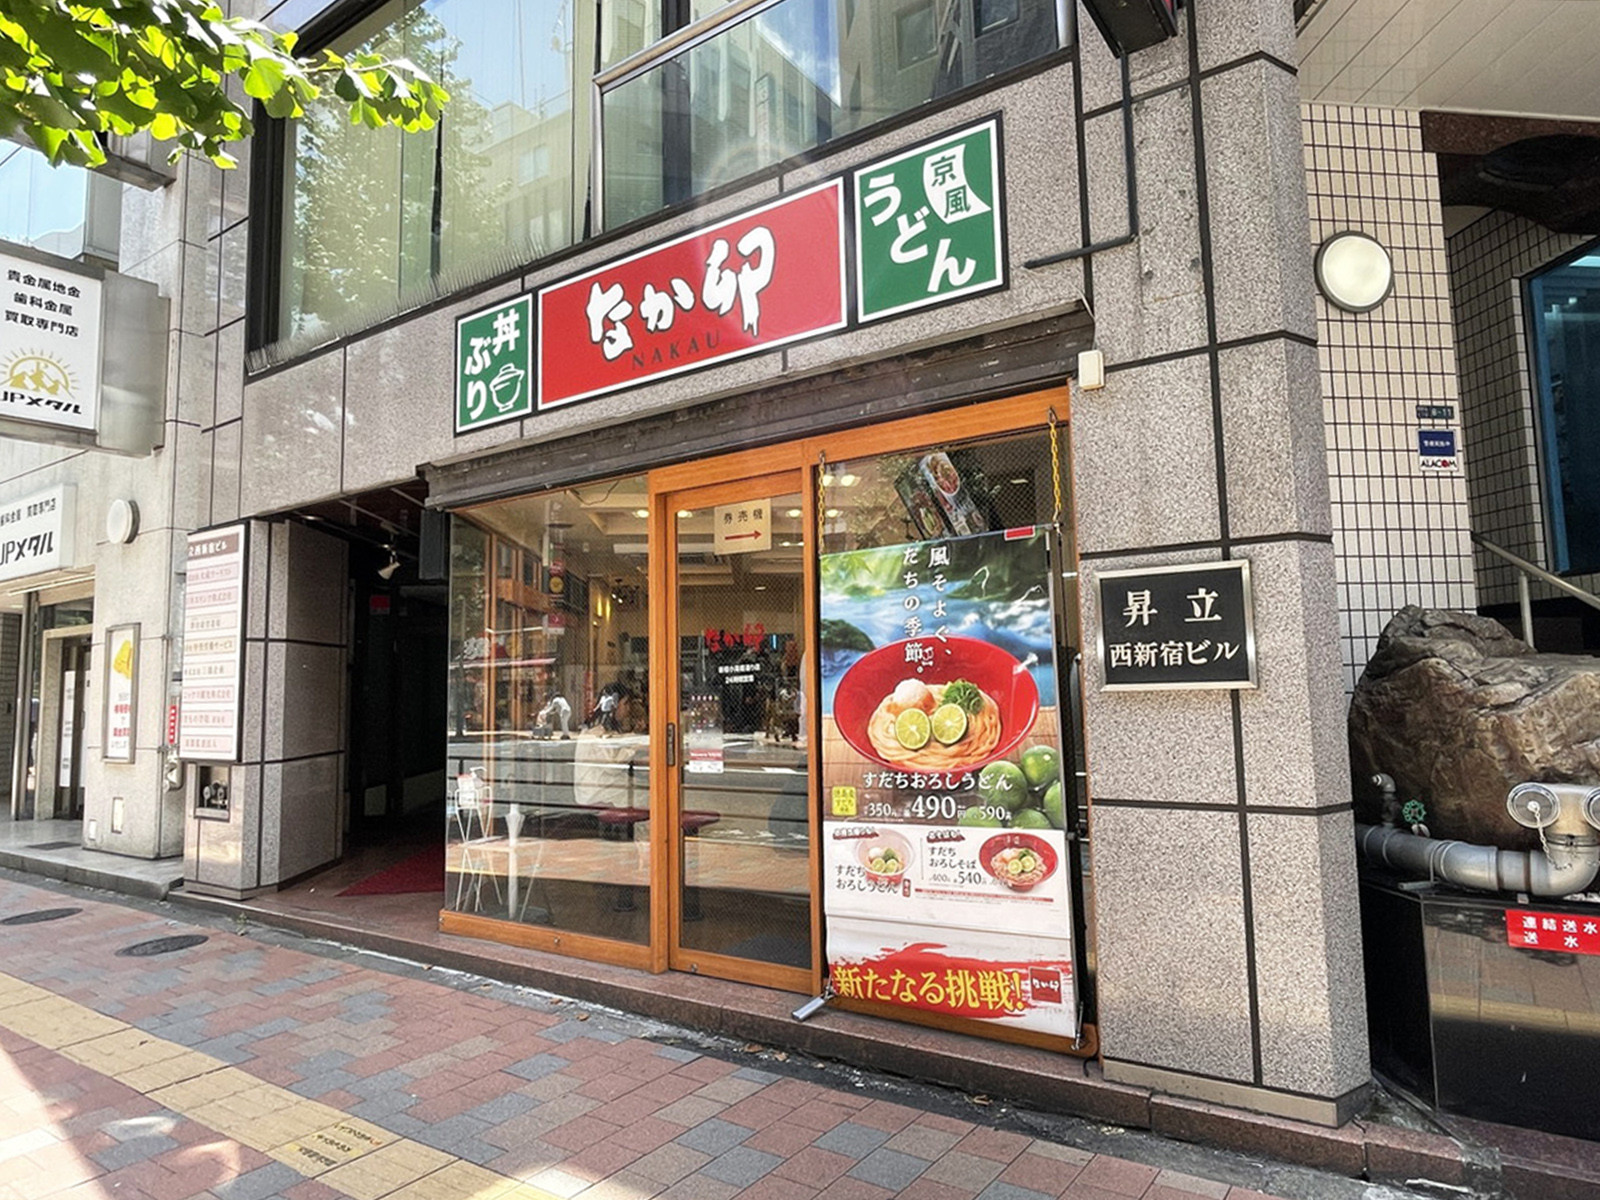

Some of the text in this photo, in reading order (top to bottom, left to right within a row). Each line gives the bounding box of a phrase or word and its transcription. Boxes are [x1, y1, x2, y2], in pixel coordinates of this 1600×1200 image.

[930, 154, 971, 219] 京風
[864, 172, 976, 293] うどん
[7, 269, 81, 299] 貴金属地金
[585, 225, 776, 361] なか卯
[13, 292, 73, 317] 歯科金属
[5, 310, 79, 338] 買取専門店
[631, 329, 723, 369] NAKAU
[724, 508, 763, 525] 券売機
[1109, 639, 1241, 669] 西新宿ビル
[862, 771, 1013, 790] すだちおろしうどん
[929, 846, 957, 857] すだち
[929, 857, 977, 869] おろしそば
[834, 863, 866, 877] すだち
[835, 878, 899, 895] おろしうどん
[834, 966, 1026, 1010] 新たなる挑戦!
